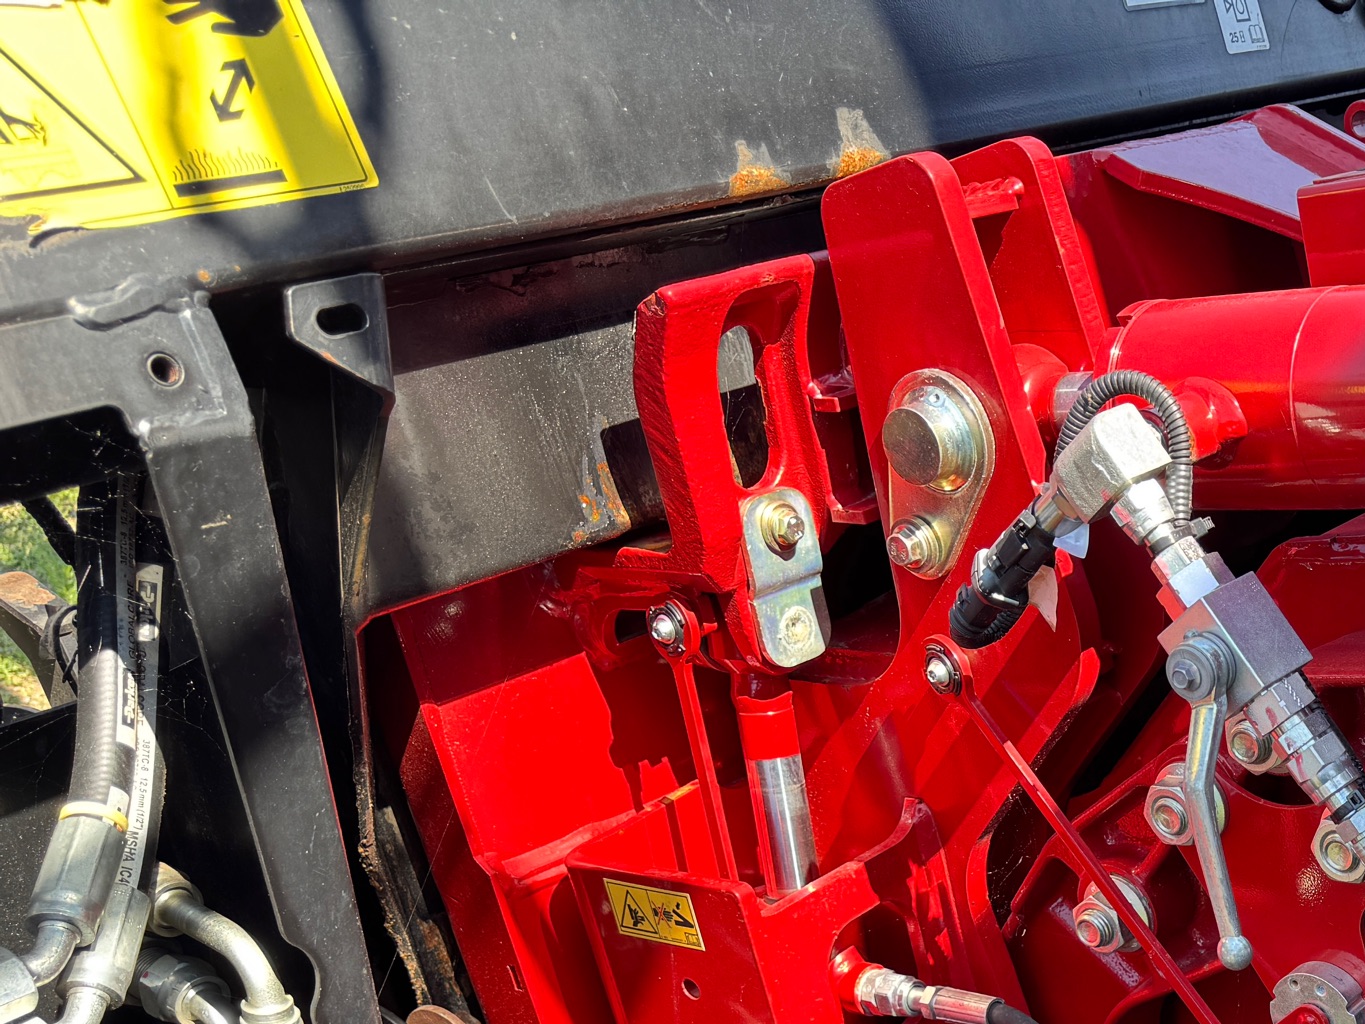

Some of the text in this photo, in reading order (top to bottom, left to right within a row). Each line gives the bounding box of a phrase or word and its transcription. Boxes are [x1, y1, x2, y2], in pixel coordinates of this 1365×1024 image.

[1229, 31, 1239, 43] 25
[141, 738, 151, 773] 387TC-8
[125, 829, 139, 863] MSHA
[118, 865, 132, 887] IC4
